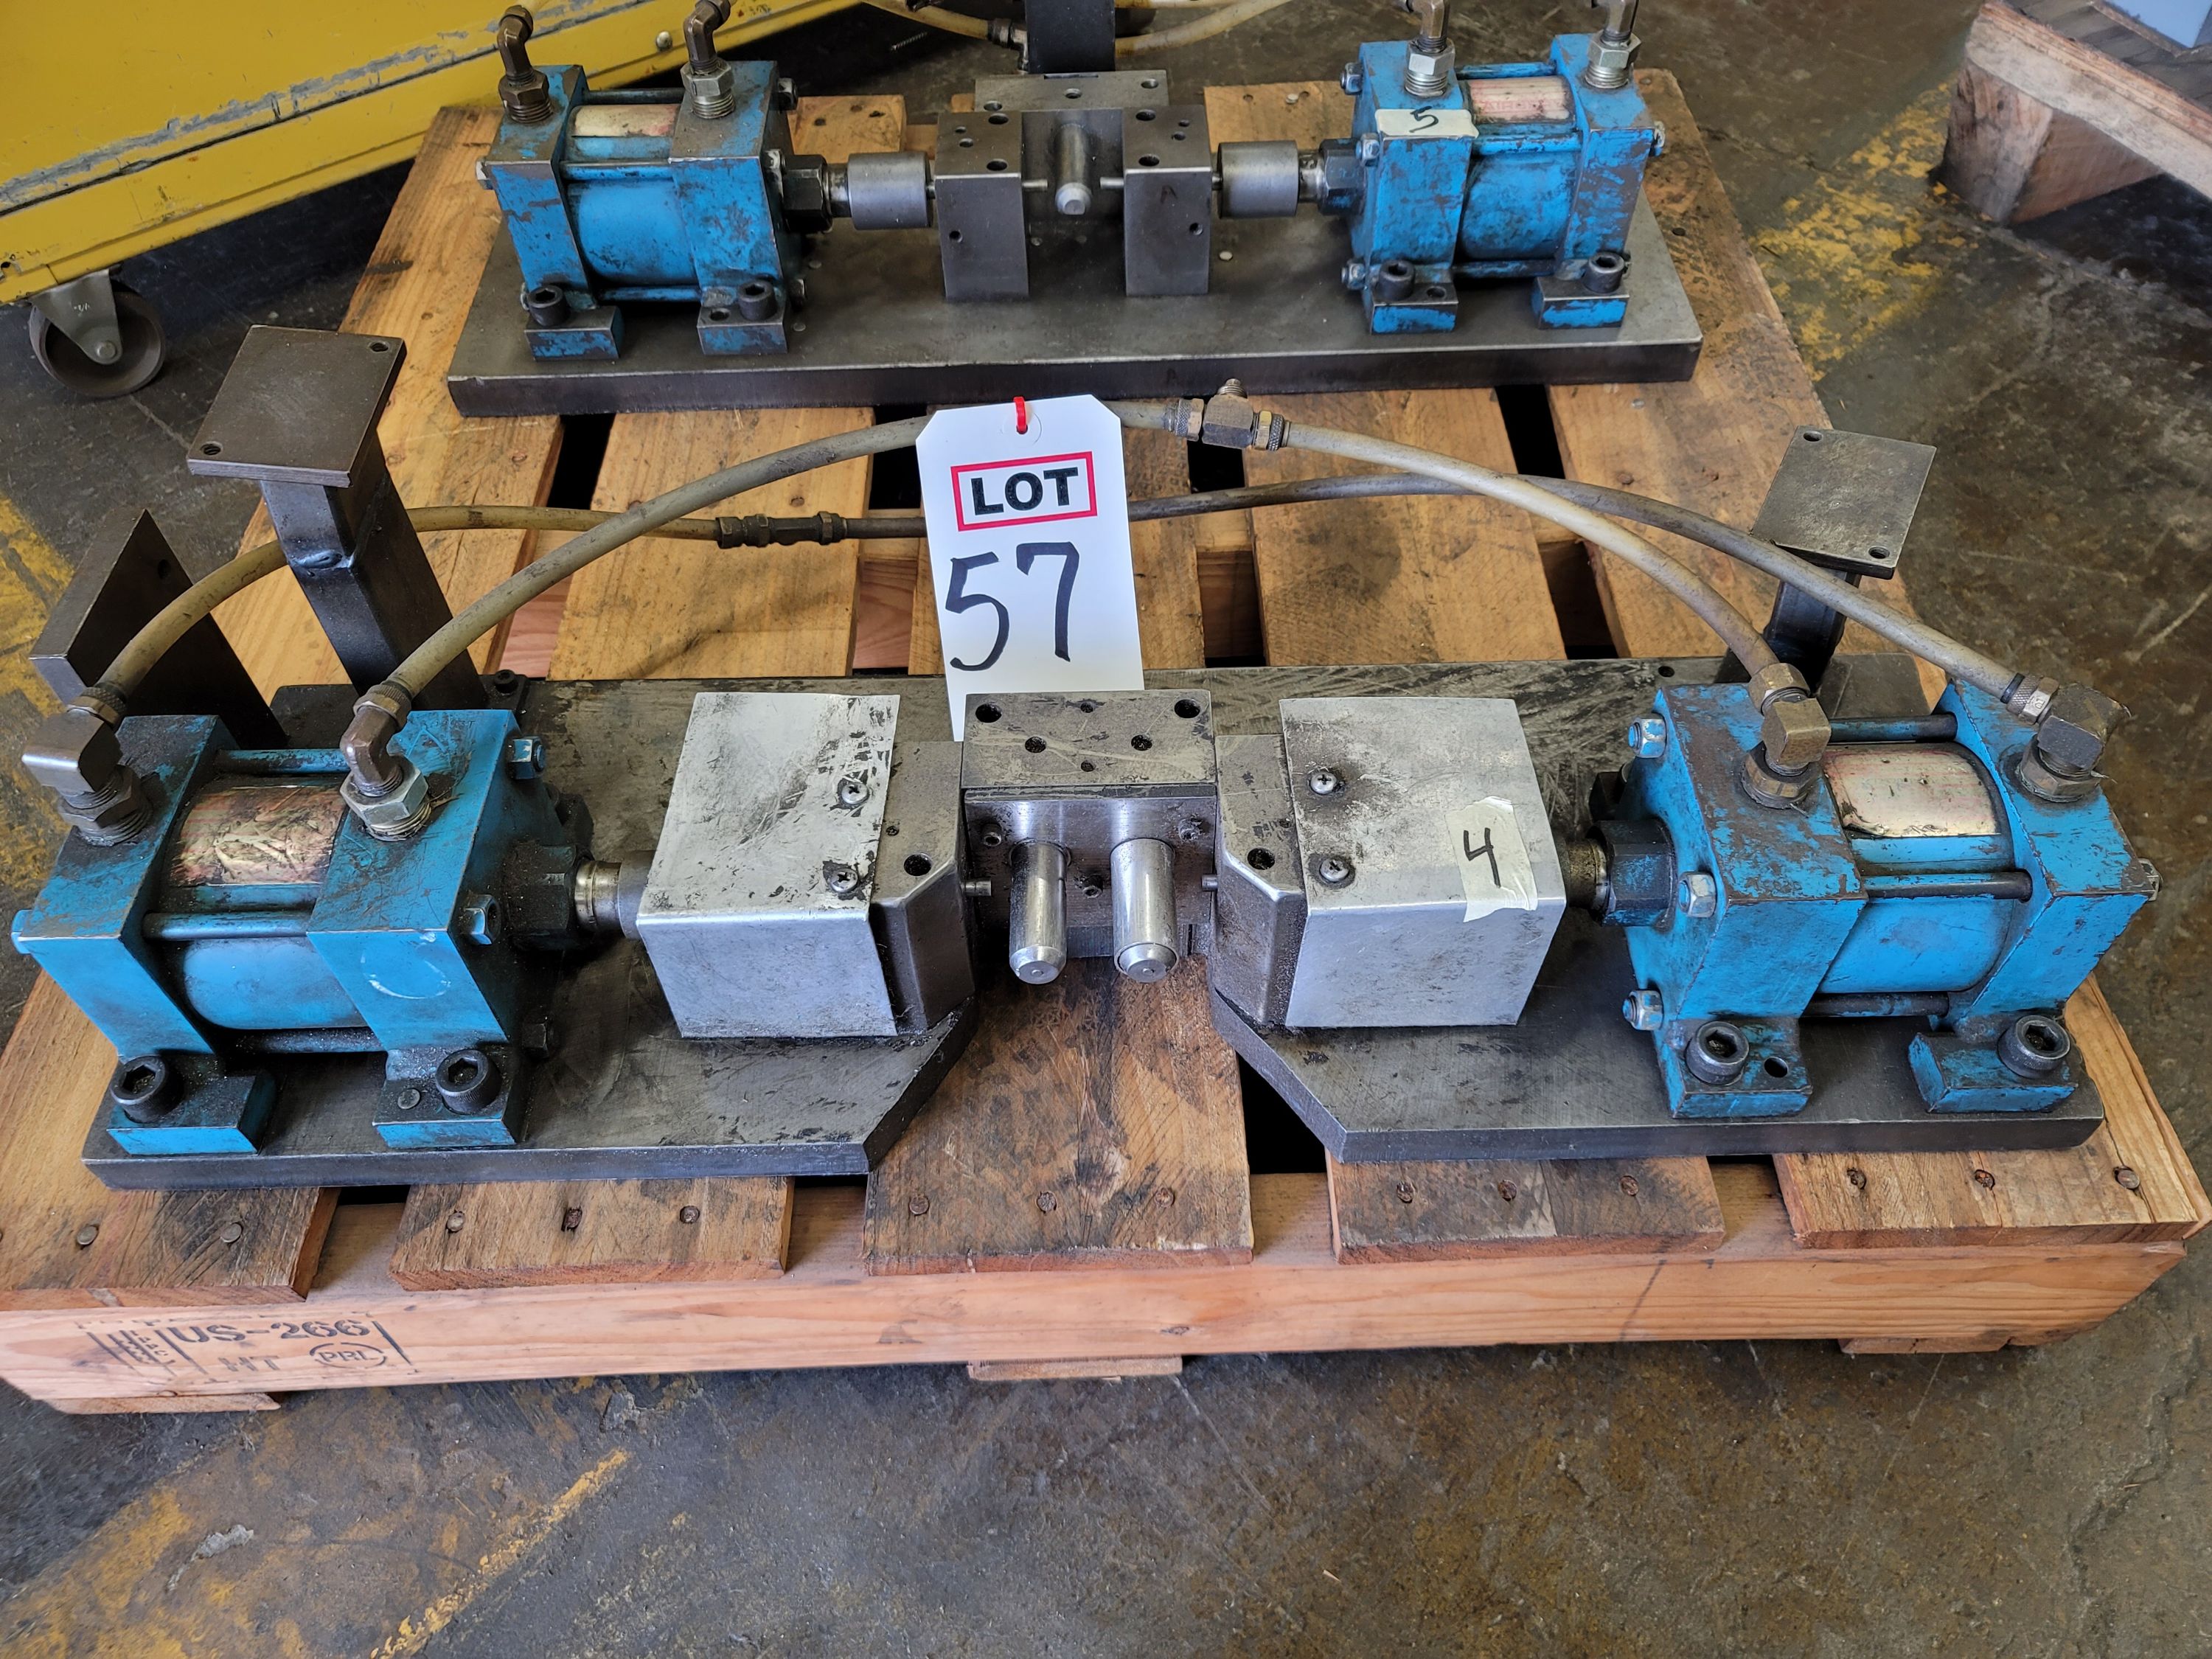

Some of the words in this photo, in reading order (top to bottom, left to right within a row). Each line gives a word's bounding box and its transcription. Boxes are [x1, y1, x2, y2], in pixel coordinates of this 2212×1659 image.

[1408, 105, 1439, 133] 5
[971, 467, 1078, 515] LOT
[945, 542, 1079, 672] 57
[1463, 827, 1501, 888] 4
[167, 1320, 370, 1343] US-266
[218, 1355, 279, 1371] HT
